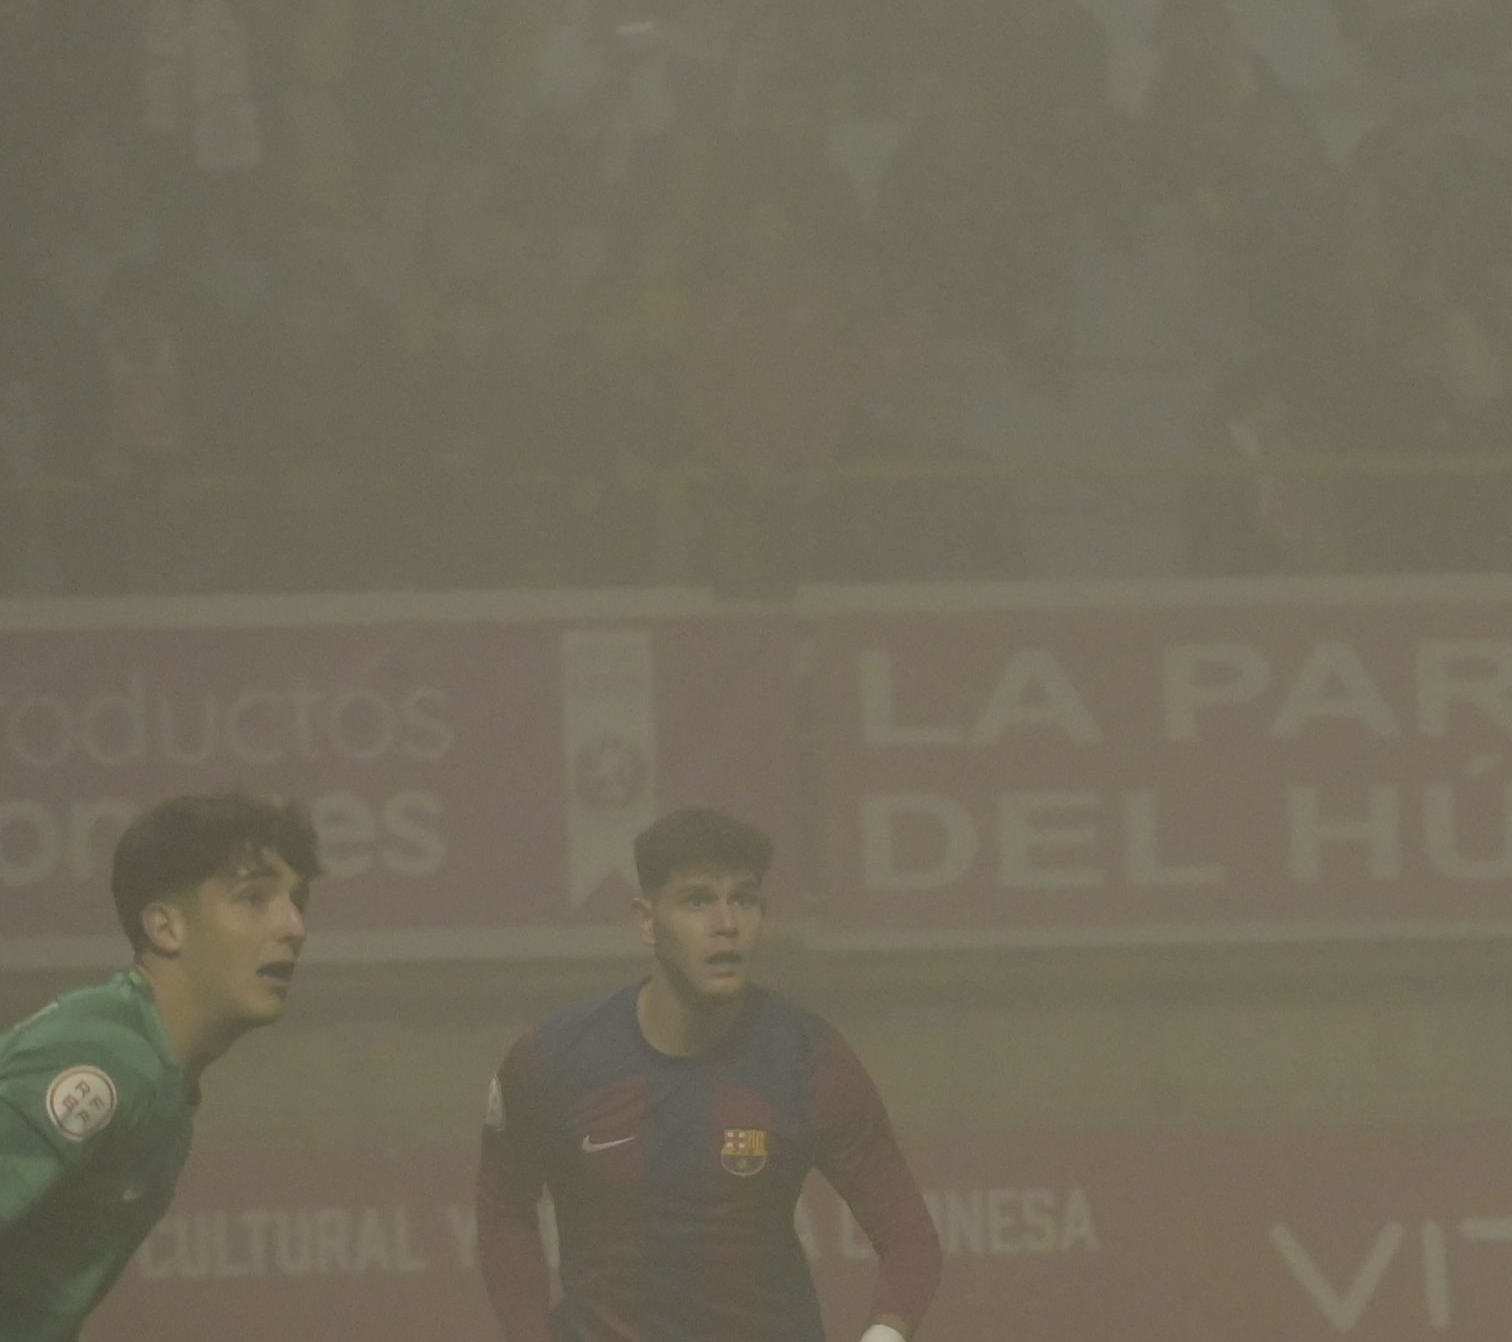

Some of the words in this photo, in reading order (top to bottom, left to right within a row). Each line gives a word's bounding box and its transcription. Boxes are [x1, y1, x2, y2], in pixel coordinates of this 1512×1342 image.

[0, 662, 455, 769] oductos
[860, 649, 1104, 746] LA
[860, 789, 1224, 891] DEL
